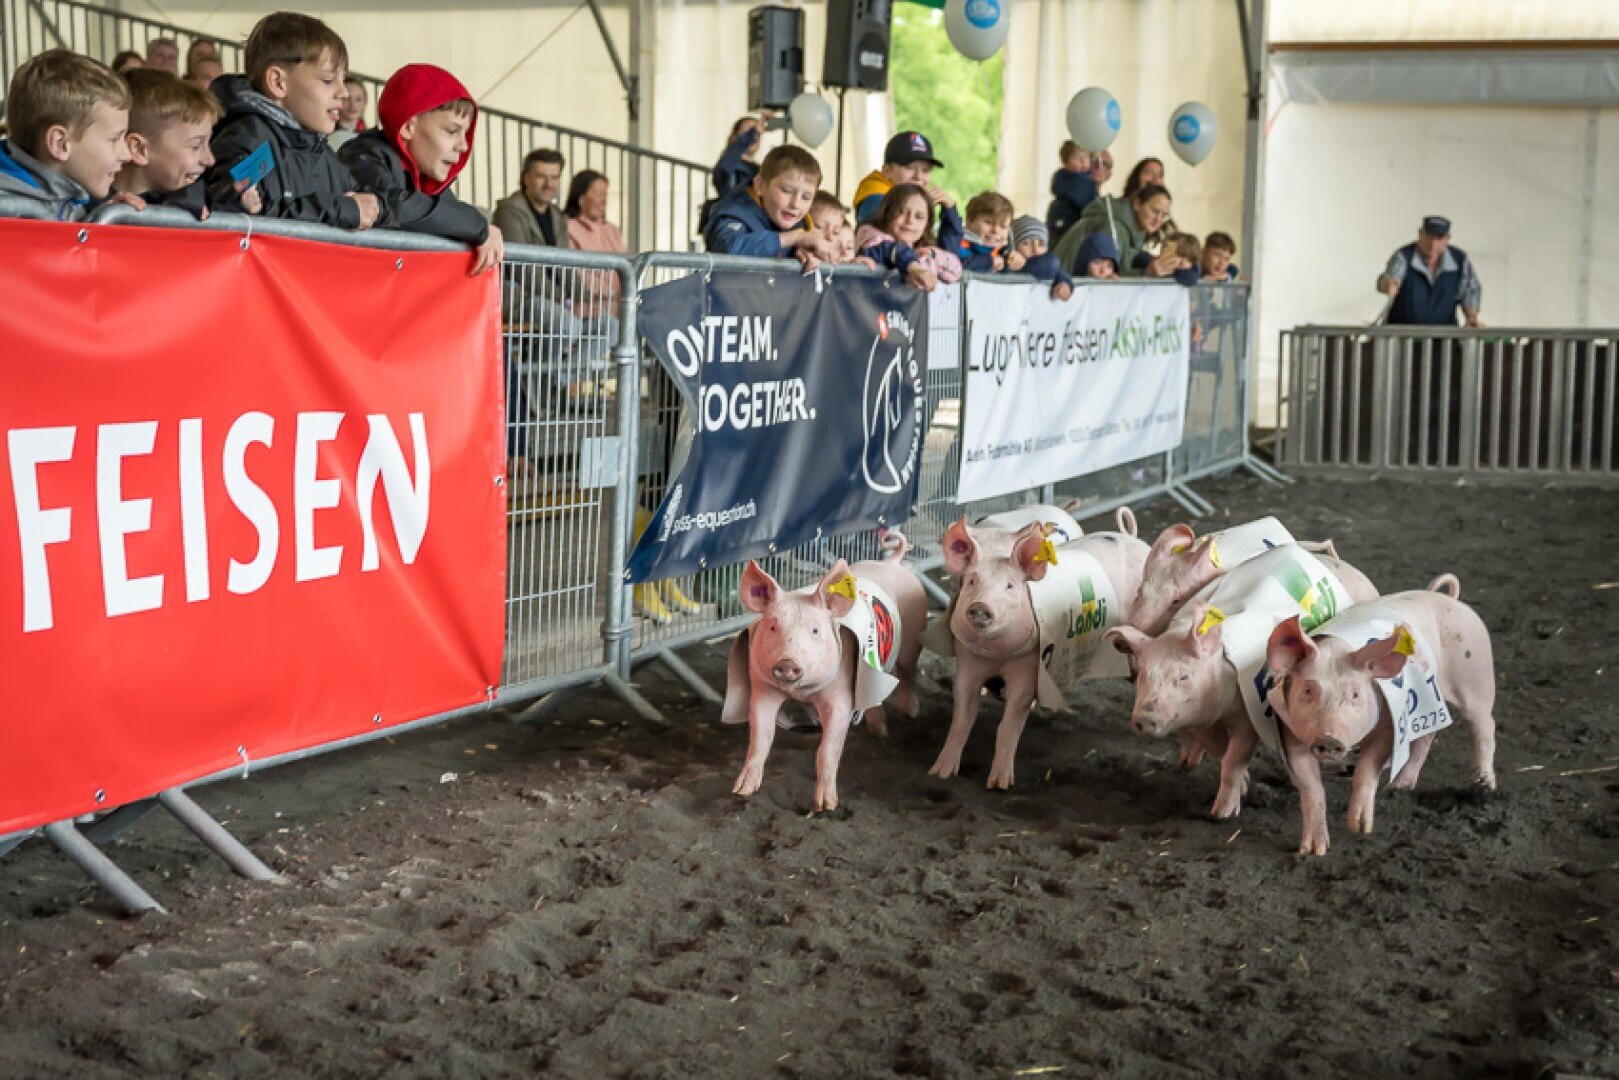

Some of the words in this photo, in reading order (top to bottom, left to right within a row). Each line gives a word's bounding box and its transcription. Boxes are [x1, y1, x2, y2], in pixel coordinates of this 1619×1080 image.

[704, 315, 778, 362] TEAM.
[699, 378, 816, 432] TOGETHER.
[8, 411, 430, 632] FEISEN
[1411, 708, 1447, 733] 6275
